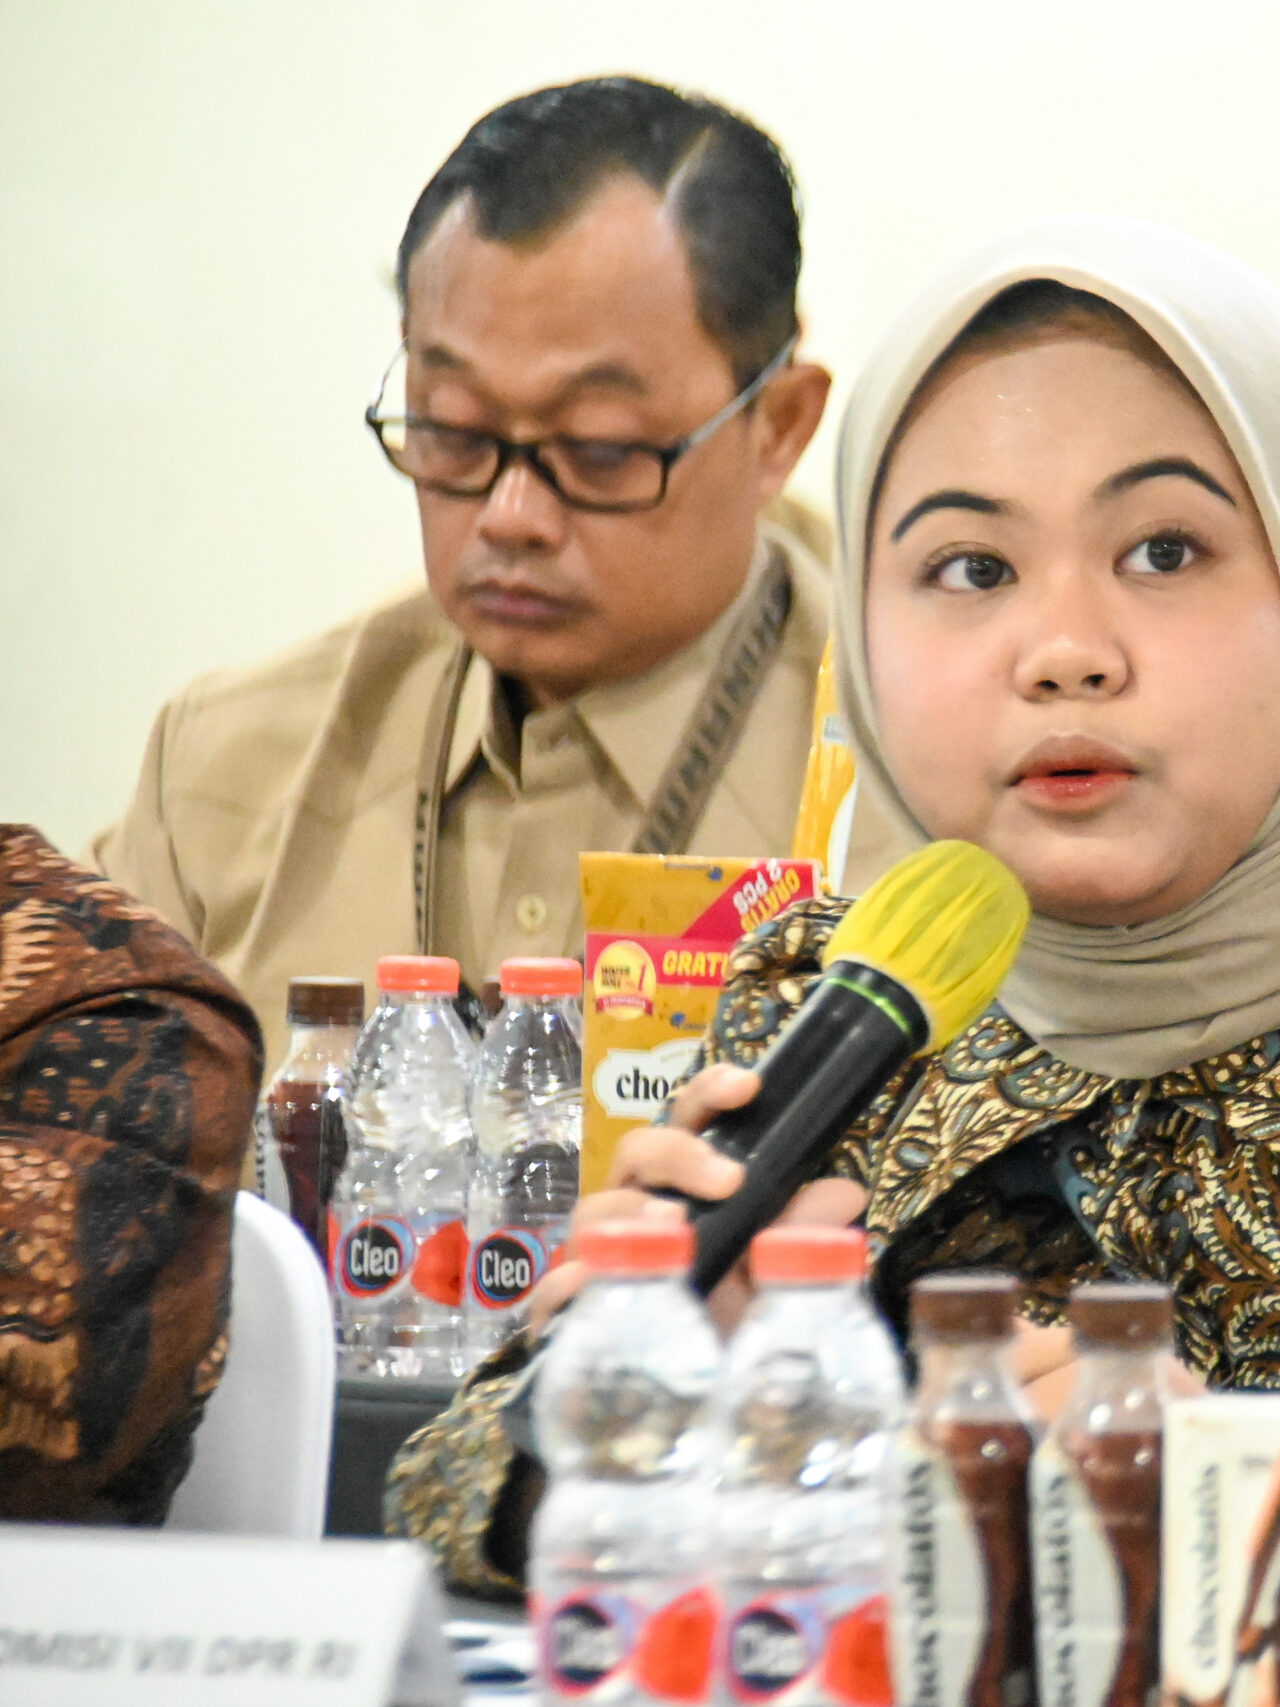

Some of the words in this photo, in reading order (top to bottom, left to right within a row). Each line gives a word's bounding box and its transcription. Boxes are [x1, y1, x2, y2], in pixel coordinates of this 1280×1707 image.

[663, 950, 730, 977] GRATI
[616, 1066, 672, 1100] cho
[351, 1238, 398, 1277] Cleo
[481, 1249, 530, 1288] Cleo
